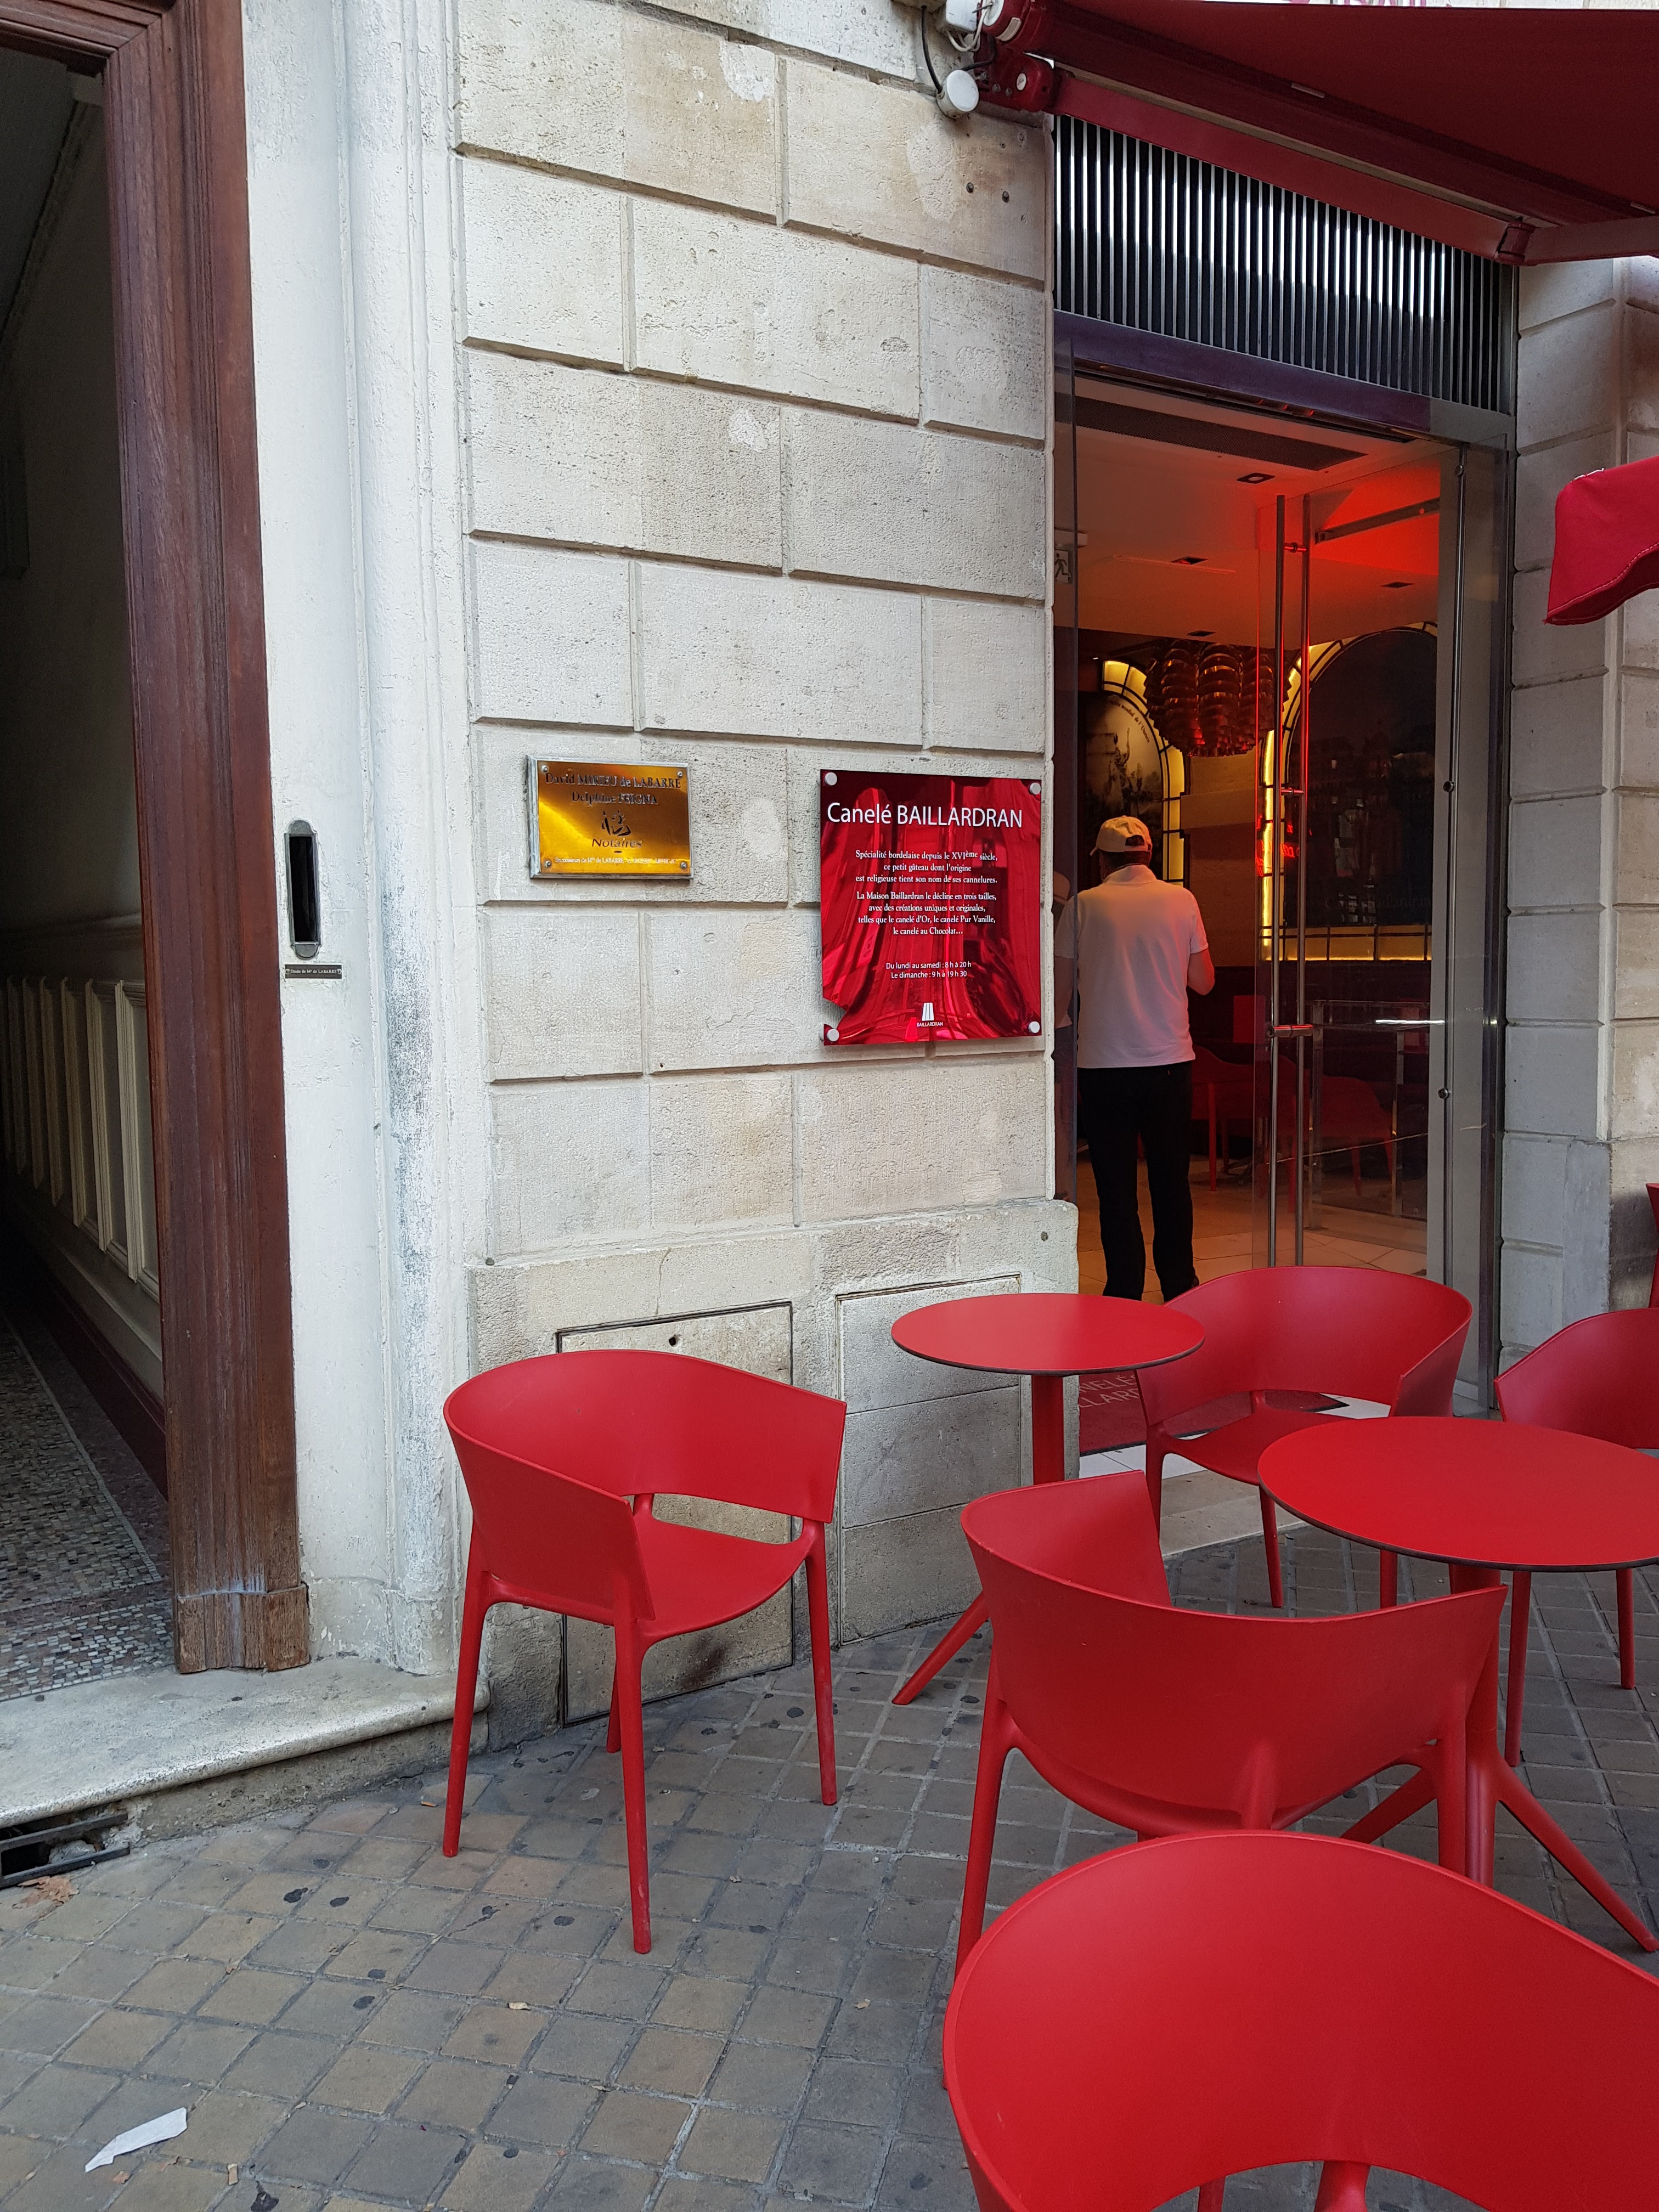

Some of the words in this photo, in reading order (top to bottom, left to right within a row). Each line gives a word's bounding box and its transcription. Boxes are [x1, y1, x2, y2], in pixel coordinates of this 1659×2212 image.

[545, 772, 575, 785] David
[619, 776, 631, 787] de
[633, 777, 681, 789] LABARRE
[572, 791, 617, 808] Delphine
[827, 802, 891, 824] Canelé
[898, 805, 1022, 828] BAILLARDRAN
[591, 837, 644, 849] Notaires
[856, 850, 887, 860] Spécialité
[889, 850, 920, 859] bordelaise
[922, 851, 943, 861] depuis
[979, 853, 998, 861] siècle,
[893, 863, 907, 872] petit
[909, 864, 929, 872] gâteau
[946, 863, 972, 873] l'origine
[867, 874, 897, 884] religieuse
[890, 891, 924, 900] Baillardran
[978, 892, 997, 900] tailles,
[884, 903, 894, 911] des
[924, 904, 947, 913] uniques
[956, 904, 986, 913] originales,
[858, 915, 874, 923] telles
[916, 915, 932, 924] d'Or,
[973, 915, 996, 924] Vanille,
[893, 927, 899, 935] le
[900, 927, 919, 935] canelé
